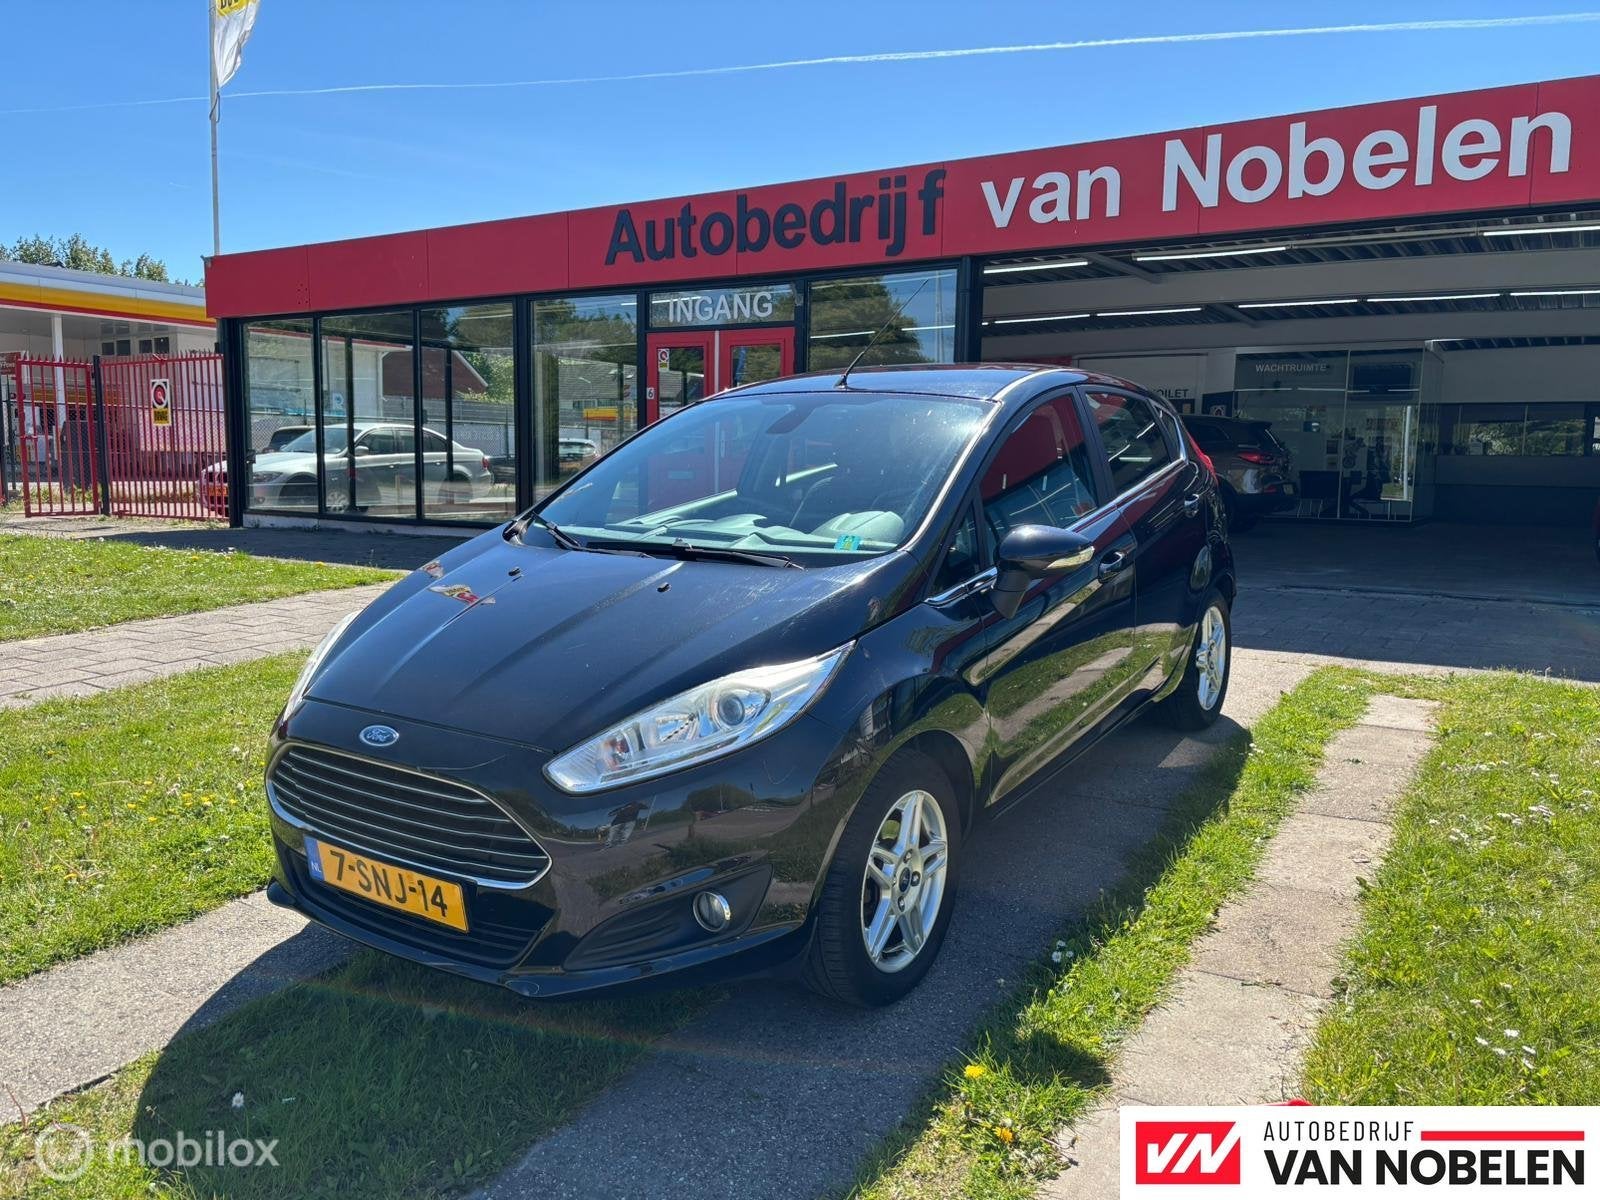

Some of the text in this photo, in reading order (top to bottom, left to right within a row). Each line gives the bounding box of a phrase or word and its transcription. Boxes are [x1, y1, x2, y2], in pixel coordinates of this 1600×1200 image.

[604, 105, 1573, 265] Autobedrijf van Nobelen
[668, 291, 774, 323] INGANG
[1255, 363, 1327, 373] WACHTRUIMTE
[311, 861, 322, 873] NL
[329, 850, 448, 918] 7-SNJ-14
